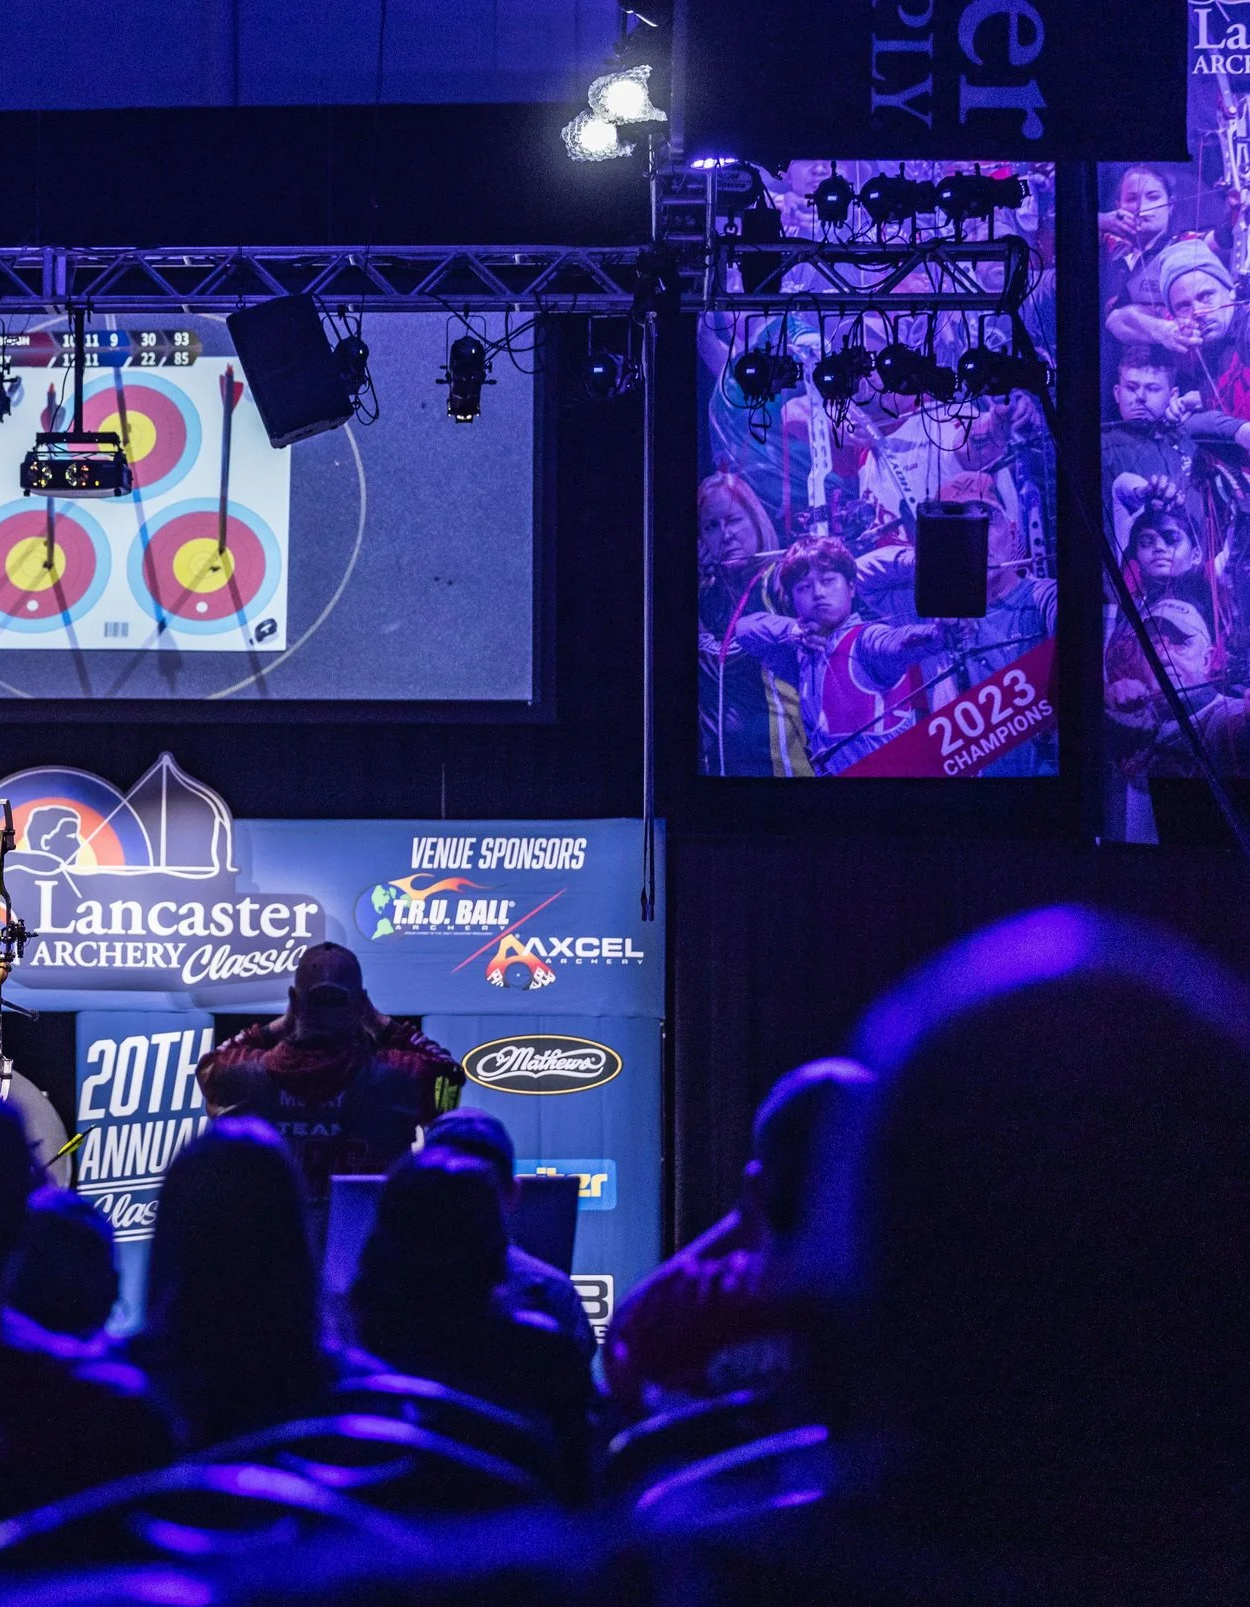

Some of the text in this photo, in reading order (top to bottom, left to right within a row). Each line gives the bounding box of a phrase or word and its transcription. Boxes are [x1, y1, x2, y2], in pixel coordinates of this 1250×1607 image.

[85, 334, 100, 347] 11
[110, 333, 119, 347] 9
[141, 333, 157, 346] 30
[174, 332, 190, 346] 93
[85, 353, 100, 366] 11
[141, 352, 156, 365] 22
[174, 352, 189, 364] 85
[928, 669, 1035, 757] 2023
[943, 699, 1053, 776] CHAMPIONS
[411, 838, 587, 869] VENUE SPONSORS
[33, 880, 318, 938] Lancaster
[393, 899, 510, 925] T.R.U. BALL
[30, 938, 306, 985] ARCHERY Classic
[522, 937, 644, 957] AXCEL
[78, 1028, 214, 1121] 20TH
[476, 1046, 607, 1081] Mathews
[79, 1116, 208, 1181] ANNUA
